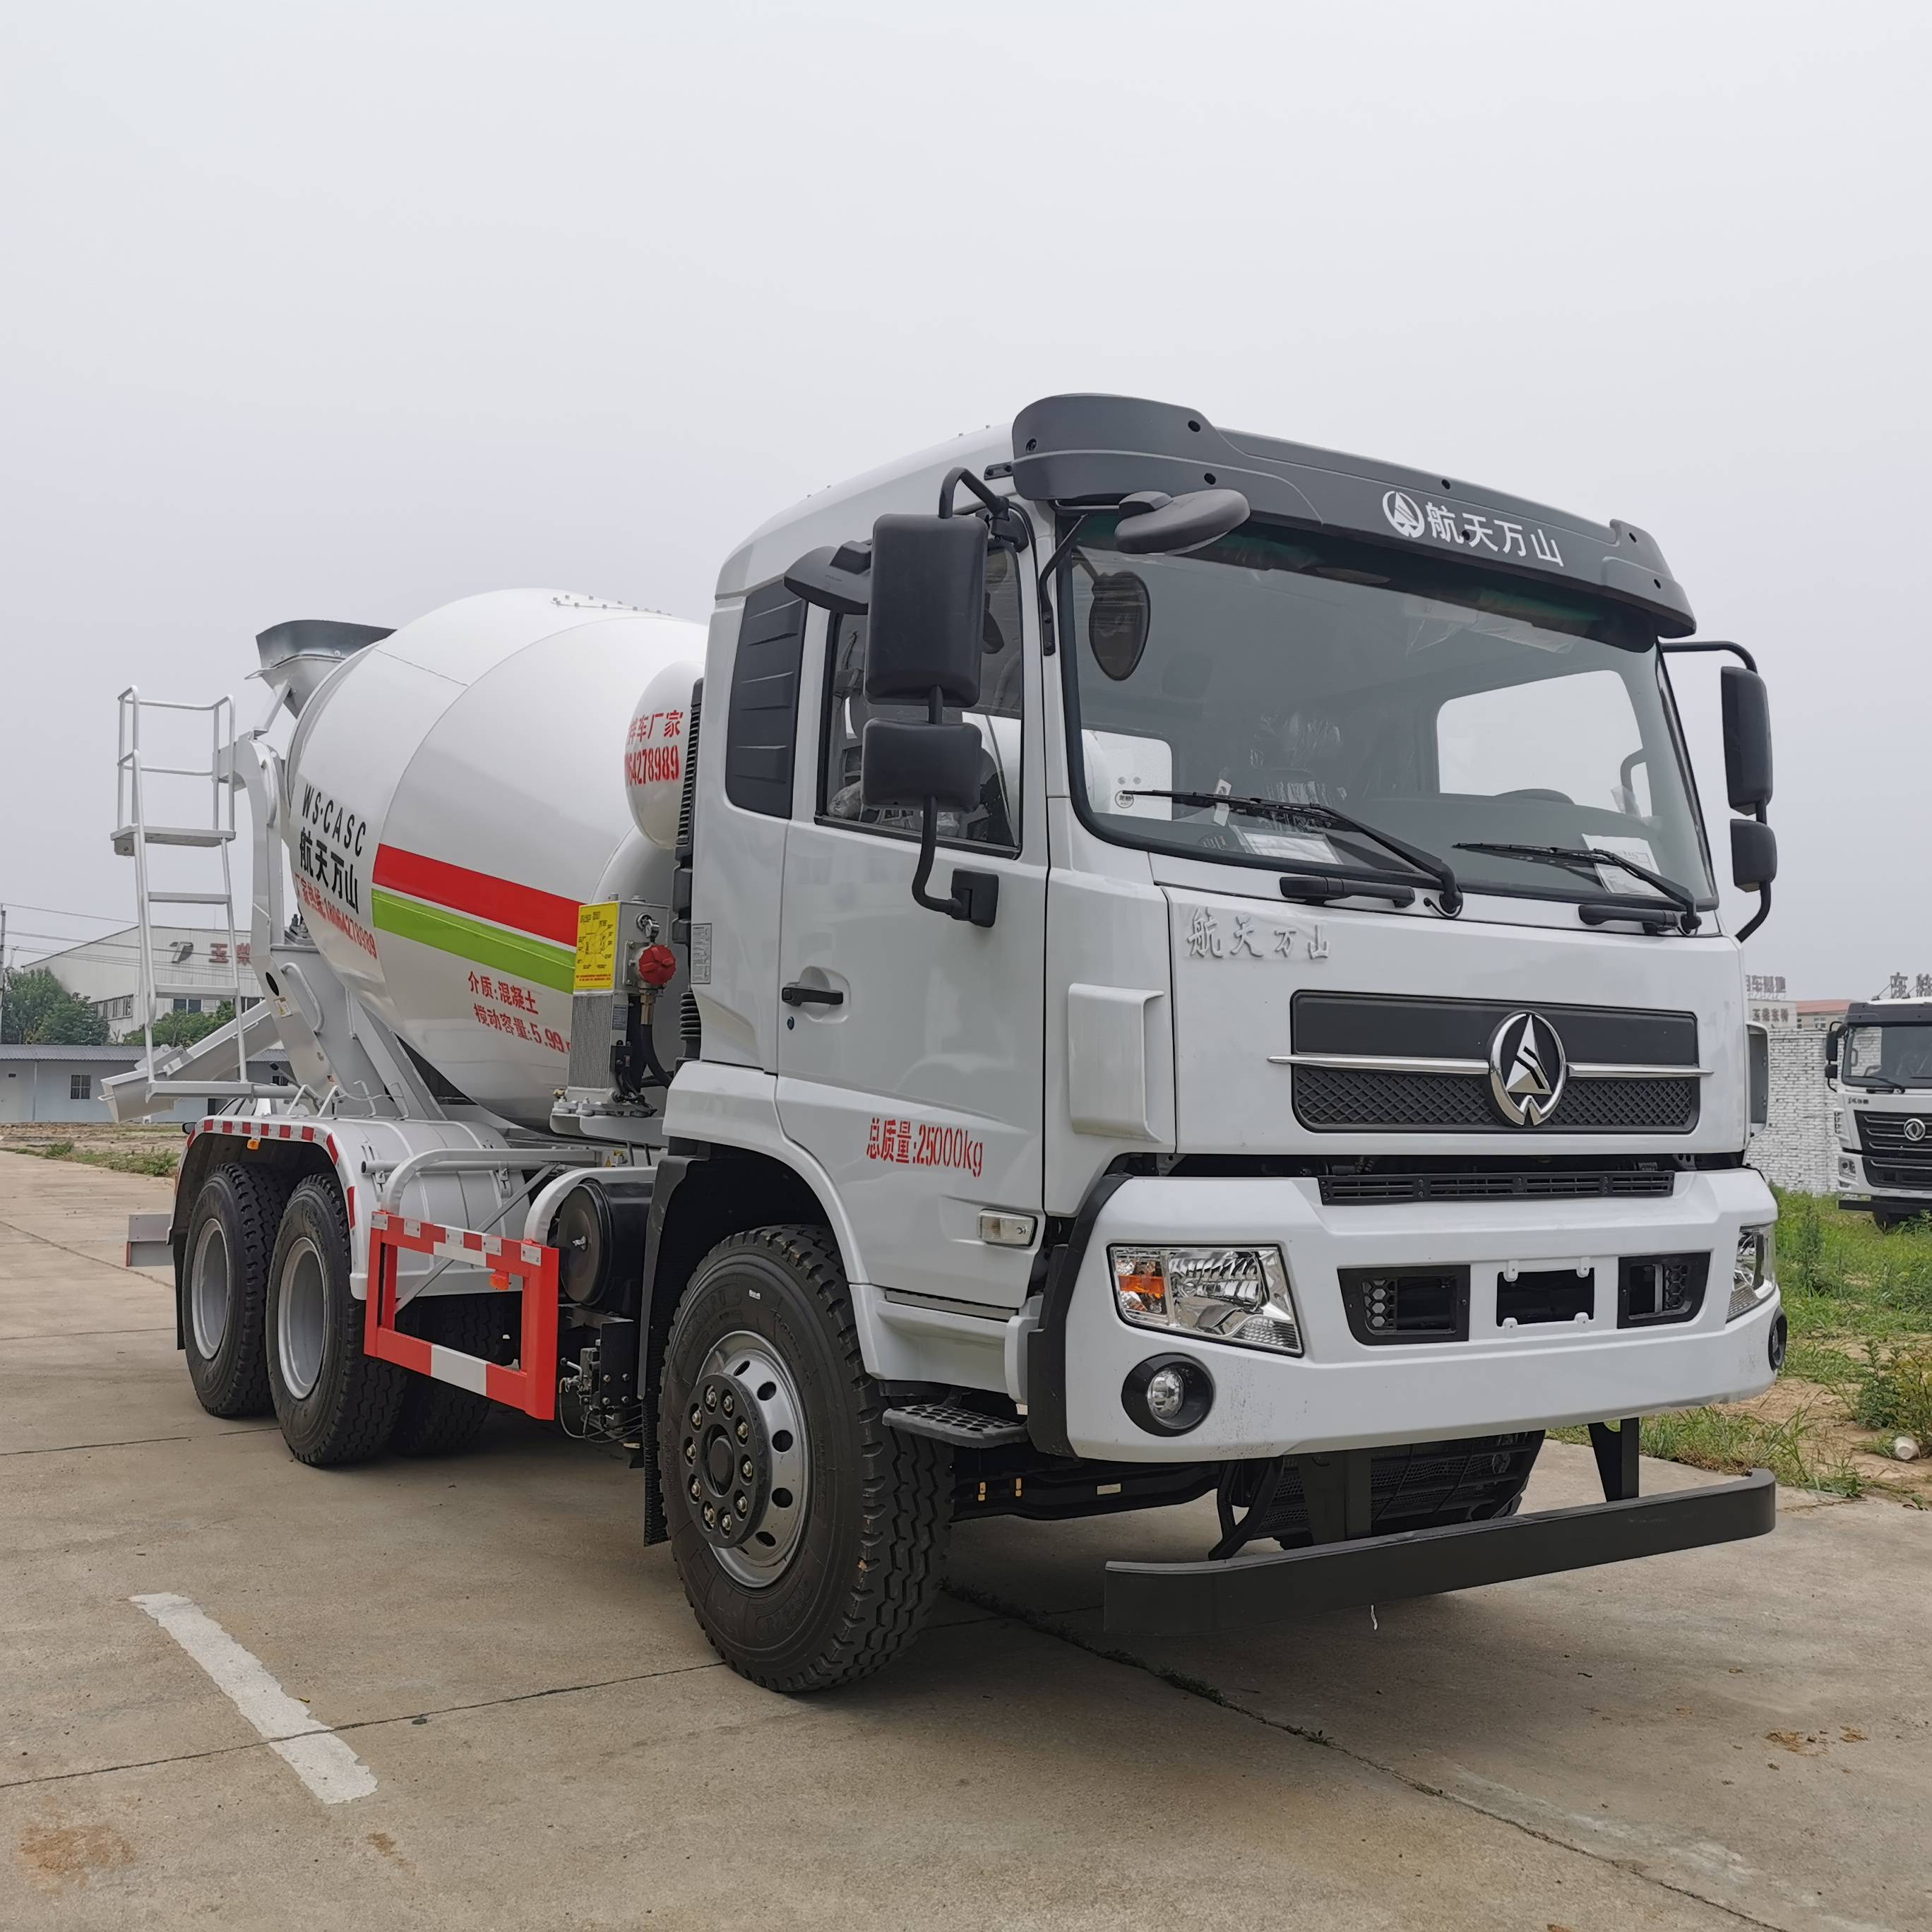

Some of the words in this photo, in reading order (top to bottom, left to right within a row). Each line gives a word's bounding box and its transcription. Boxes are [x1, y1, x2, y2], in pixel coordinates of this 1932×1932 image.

[1425, 501, 1564, 567] 航天万山
[625, 745, 679, 787] 64278989
[299, 826, 359, 914] 航天万山
[209, 943, 251, 966] 玉柴
[1186, 906, 1330, 960] 航天万山
[467, 970, 539, 1015] 介质:混凝土
[866, 1117, 984, 1178] 总质量:25000kg
